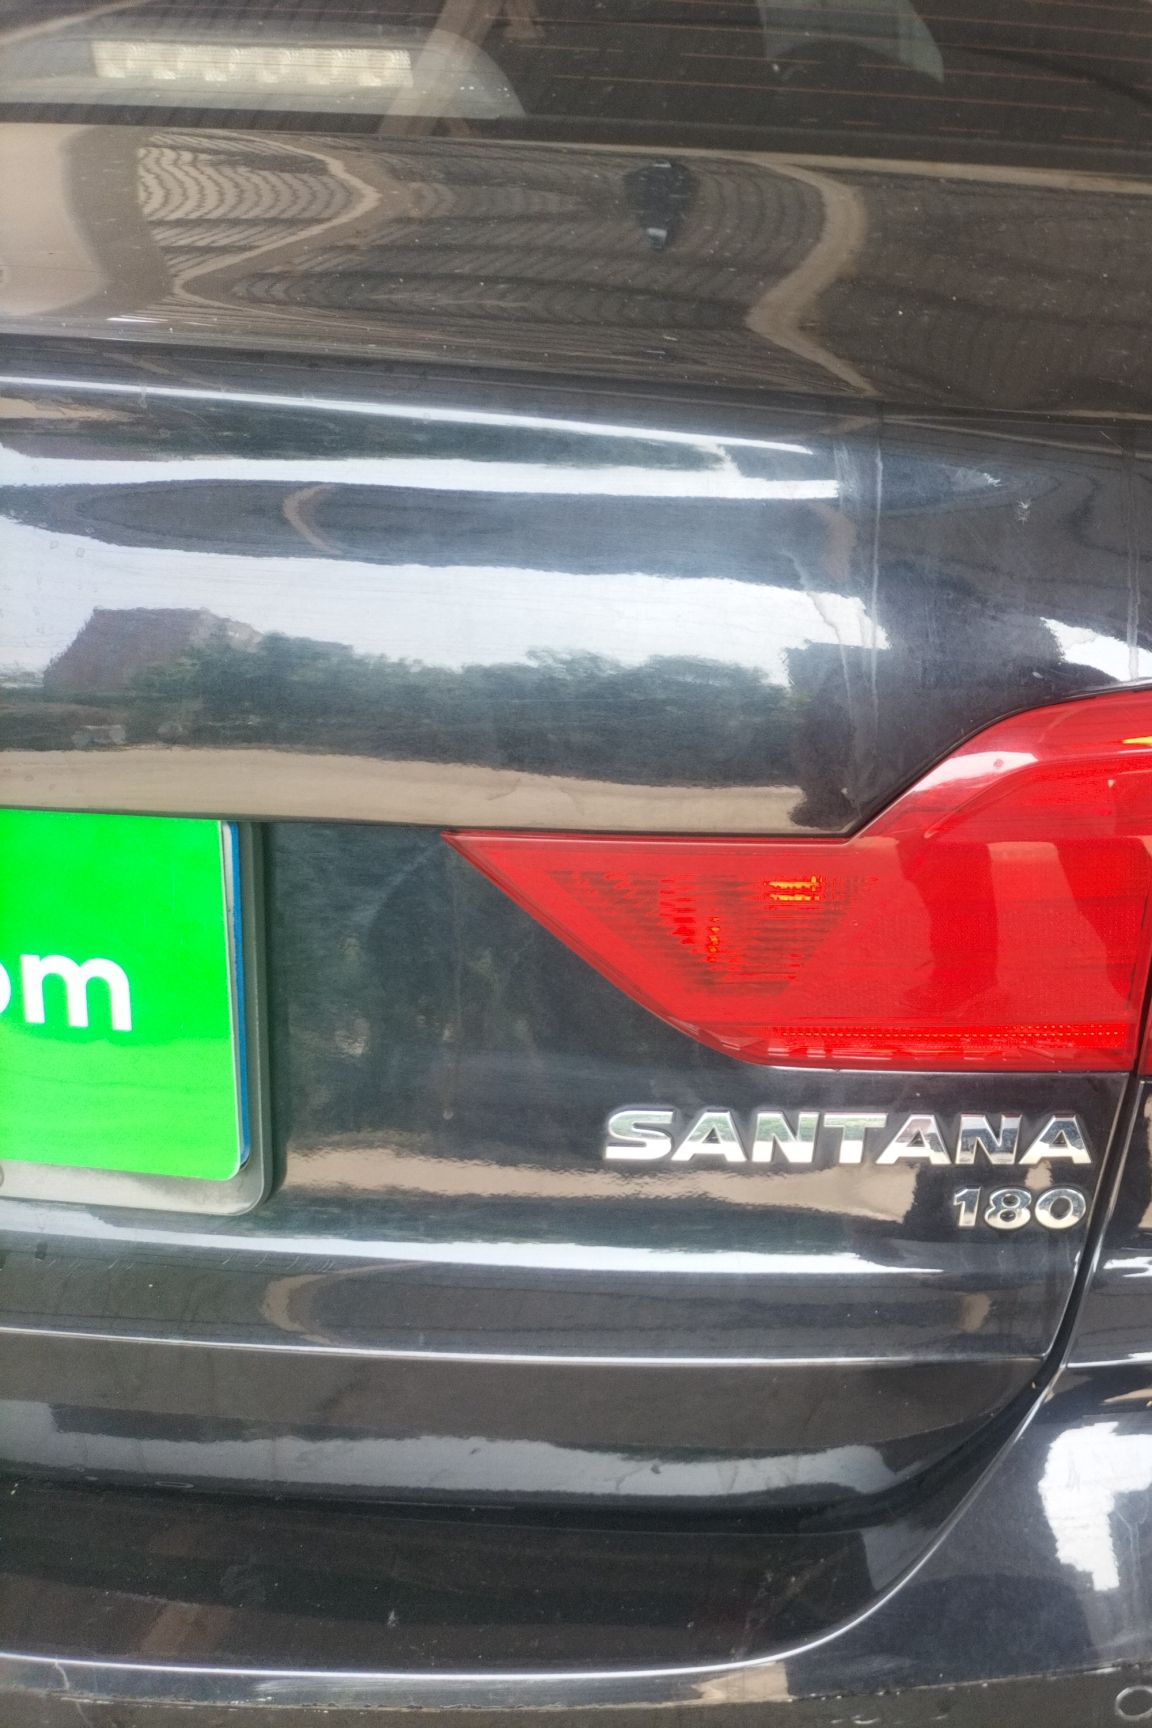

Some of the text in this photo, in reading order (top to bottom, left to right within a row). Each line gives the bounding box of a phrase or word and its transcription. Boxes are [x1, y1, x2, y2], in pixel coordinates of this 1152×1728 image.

[0, 953, 132, 1032] m
[604, 1108, 1092, 1165] SANTANA
[953, 1187, 1087, 1229] 180
